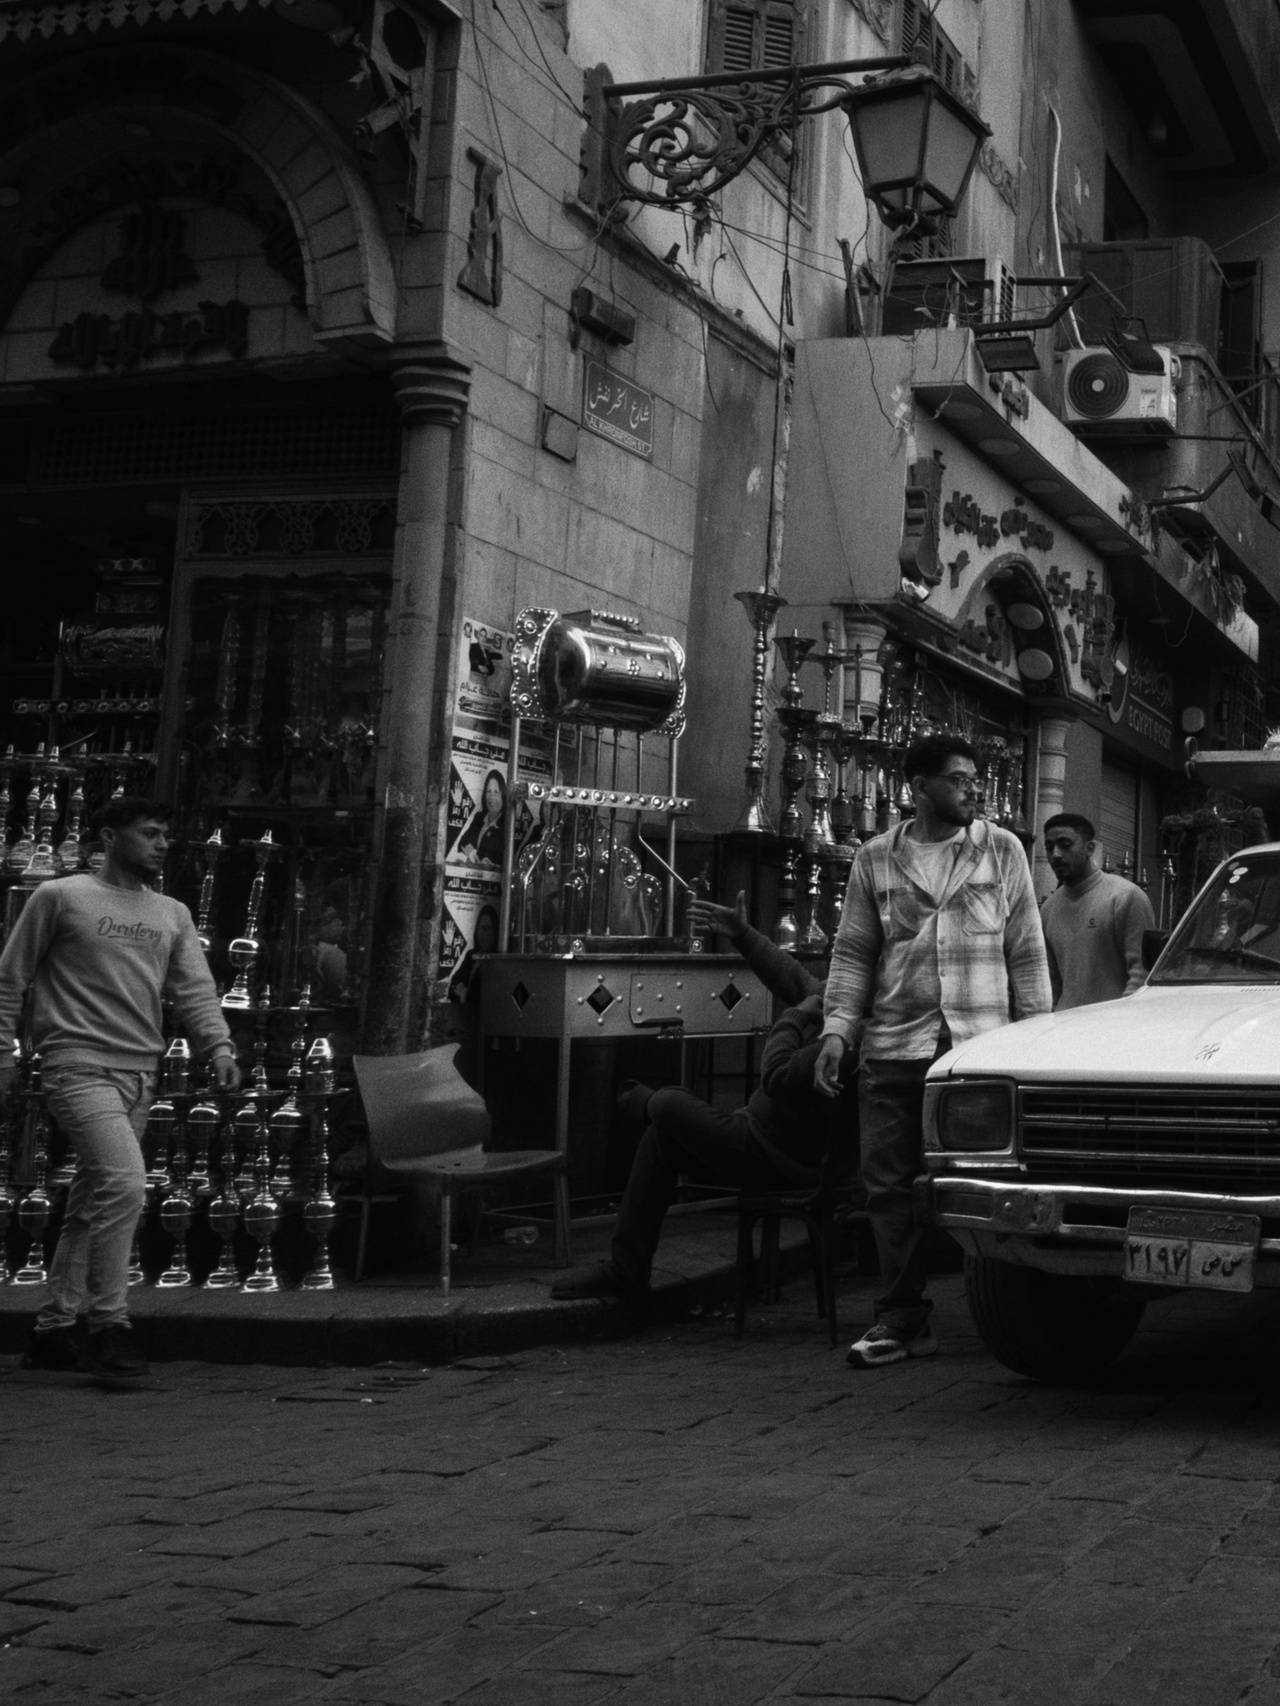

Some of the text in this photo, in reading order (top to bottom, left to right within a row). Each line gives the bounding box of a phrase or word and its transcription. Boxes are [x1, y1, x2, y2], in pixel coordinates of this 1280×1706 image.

[630, 401, 649, 429] شارع
[590, 416, 598, 428] AL
[1128, 704, 1172, 751] EGYPT POST
[456, 739, 469, 750] الله
[1141, 1215, 1181, 1229] EGYPT
[1207, 1221, 1245, 1234] مصر
